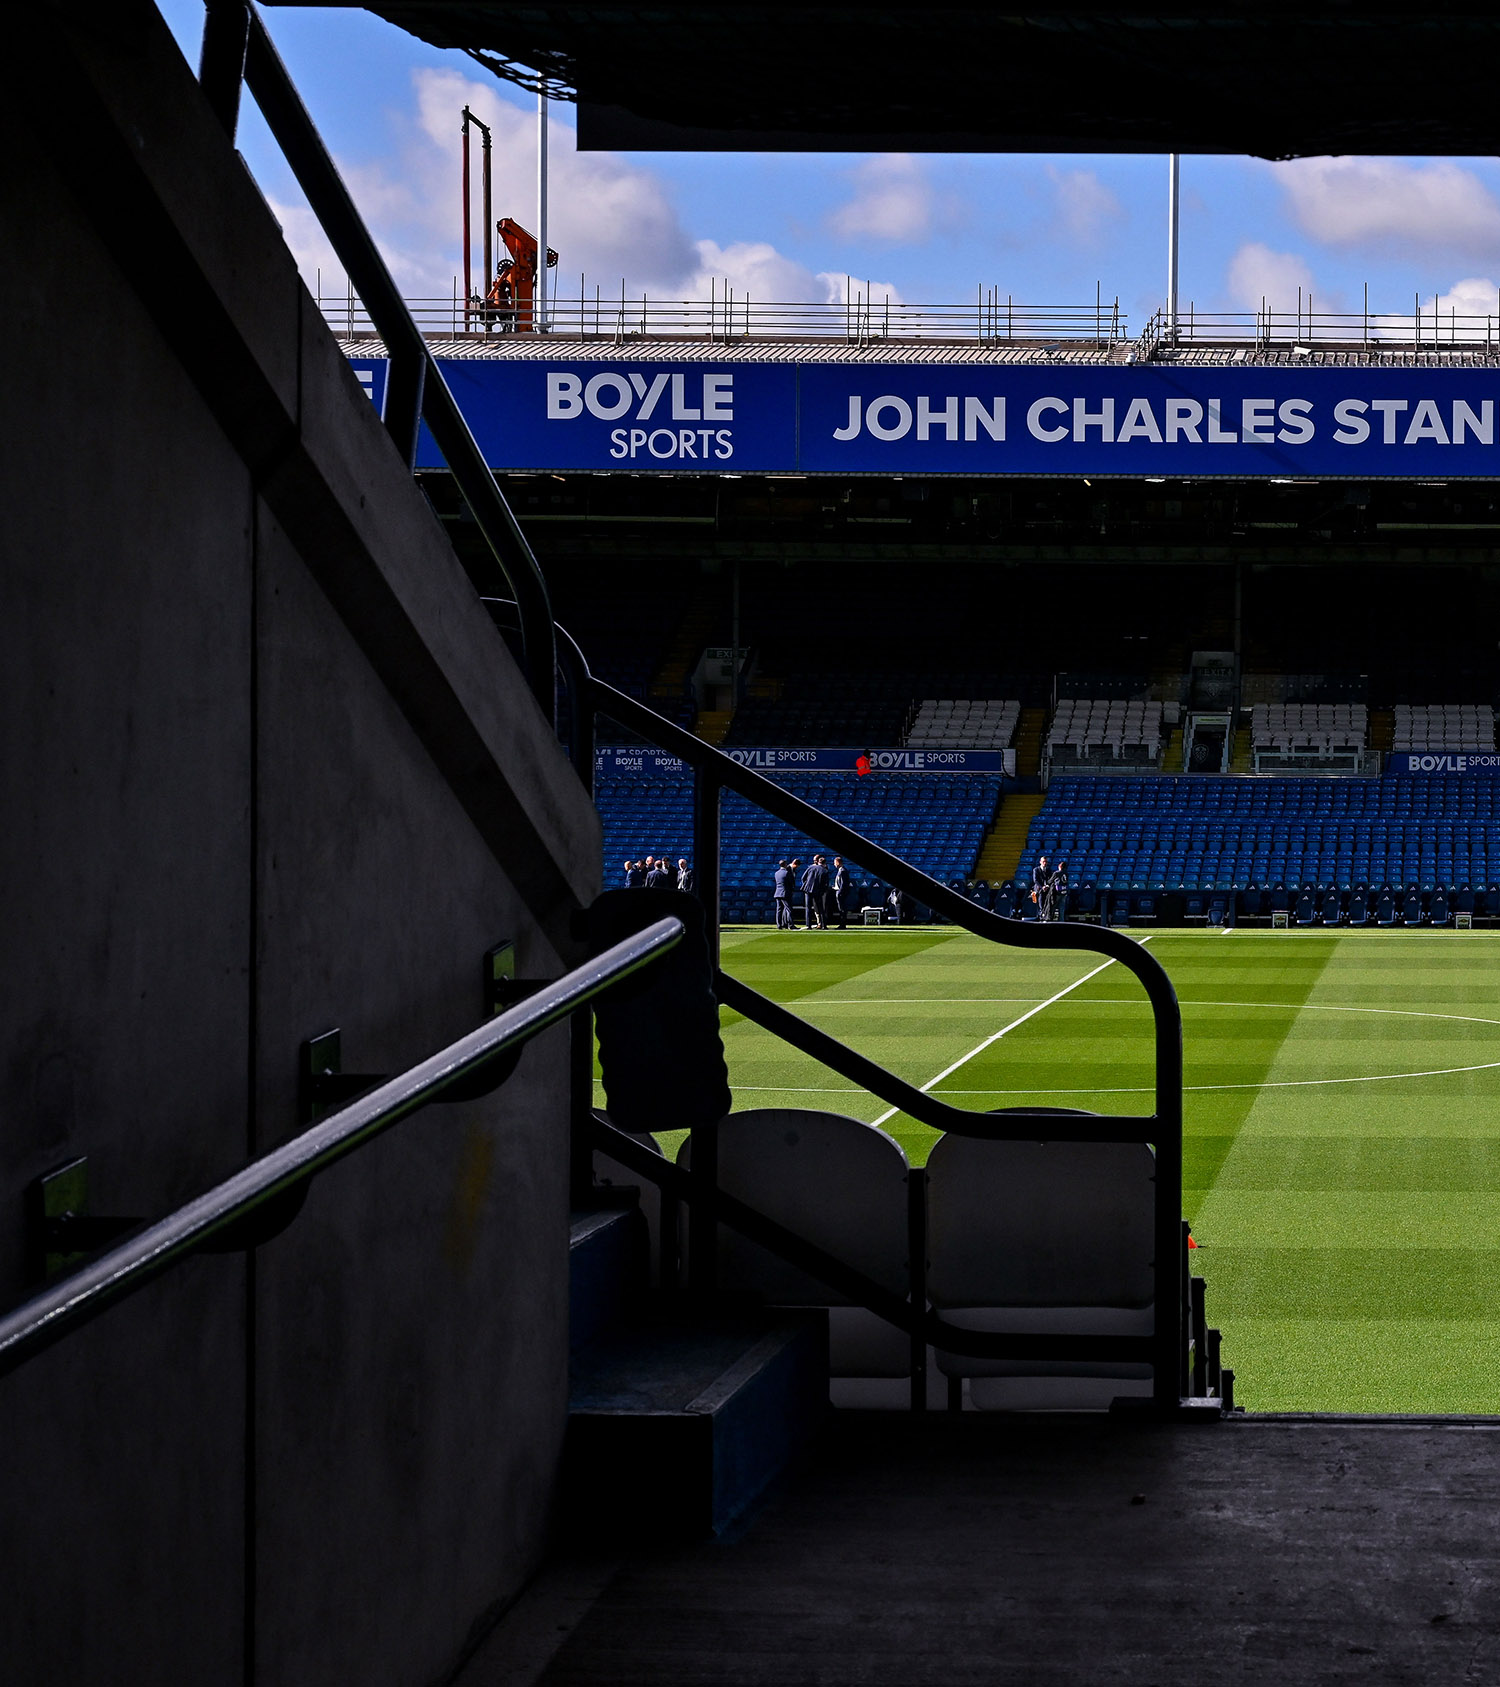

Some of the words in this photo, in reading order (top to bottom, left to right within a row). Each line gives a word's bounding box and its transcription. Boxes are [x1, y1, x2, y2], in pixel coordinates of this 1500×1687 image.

[548, 373, 733, 421] BOYLE
[833, 396, 1005, 441] JOHN
[1027, 397, 1314, 445] CHARLES
[610, 429, 733, 459] SPORTS
[615, 757, 643, 765] BOYLE
[655, 758, 683, 766] BOYLE
[720, 751, 775, 766] OYLE
[778, 751, 816, 762] SPORTS
[869, 752, 924, 768] BOYLE
[927, 753, 965, 763] SPORTS
[1409, 756, 1466, 771] BOYLE
